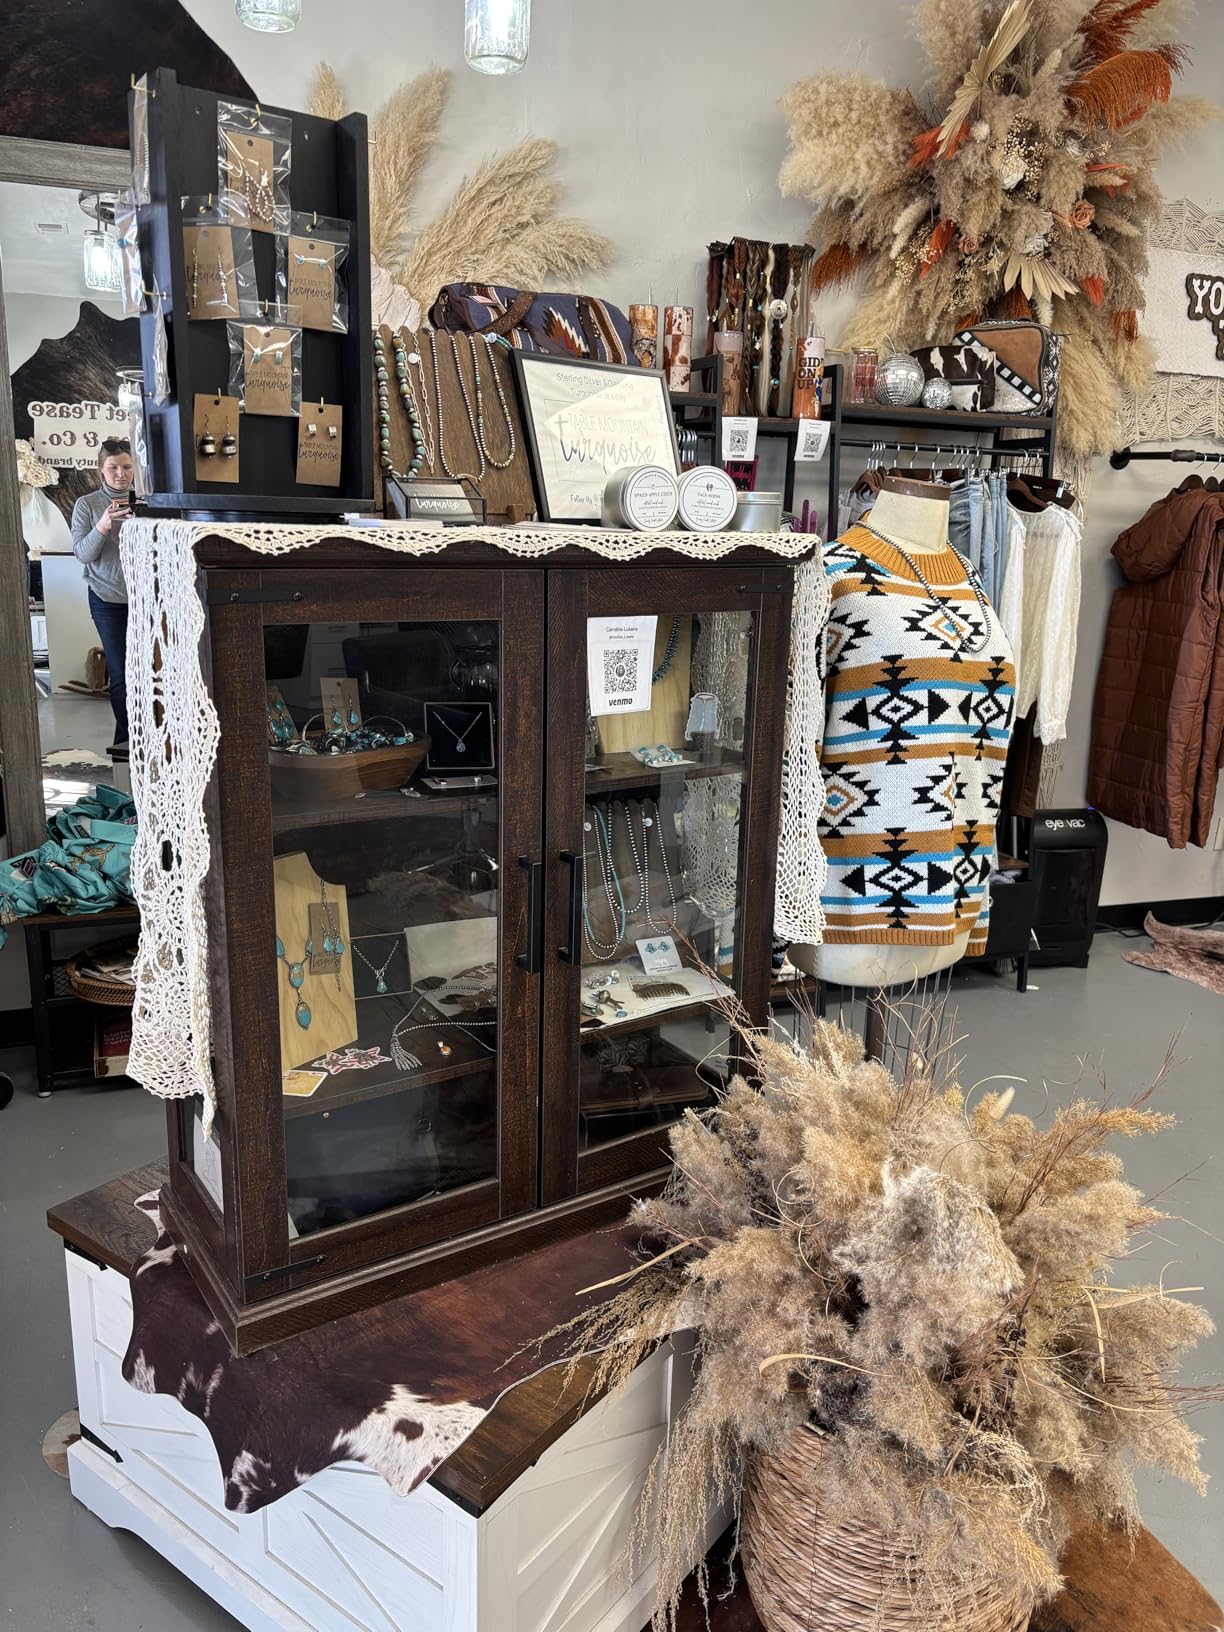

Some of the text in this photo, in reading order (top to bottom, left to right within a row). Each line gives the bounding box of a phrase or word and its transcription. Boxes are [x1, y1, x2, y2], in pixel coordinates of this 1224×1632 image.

[556, 372, 583, 386] Sterling
[583, 377, 602, 386] Silver
[797, 367, 817, 379] ON
[245, 371, 291, 392] turquoise
[797, 379, 814, 389] UP
[567, 412, 650, 436] TABLE MOUNTAIN
[554, 413, 657, 477] turquoise
[298, 442, 339, 463] turquoise
[608, 697, 633, 706] venmo
[1045, 819, 1086, 831] eye vac
